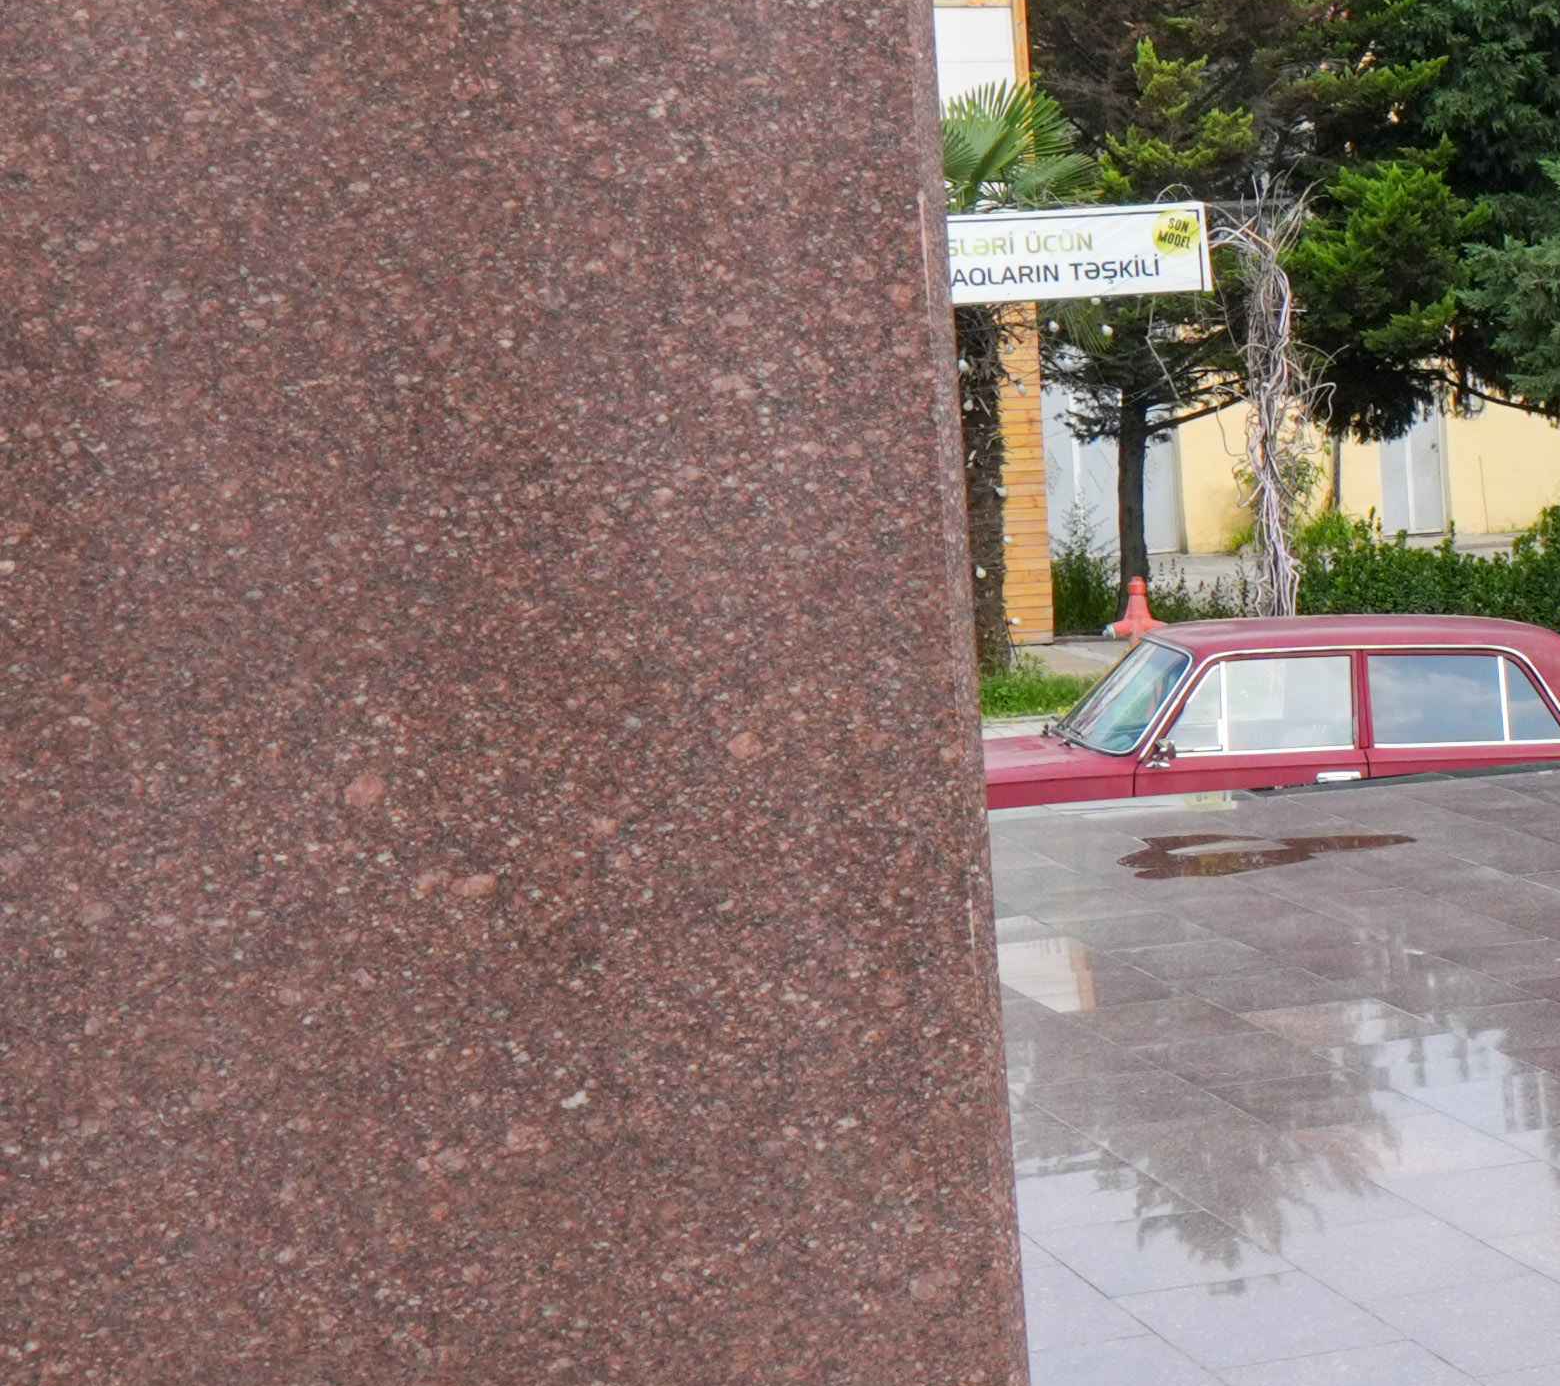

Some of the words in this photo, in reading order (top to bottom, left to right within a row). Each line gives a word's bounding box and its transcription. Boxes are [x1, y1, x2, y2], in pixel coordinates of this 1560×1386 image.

[1168, 217, 1190, 233] SON
[1157, 230, 1191, 249] MODEL
[951, 263, 1059, 287] AQLARIN
[1069, 253, 1160, 284] TƏŞKİLİ
